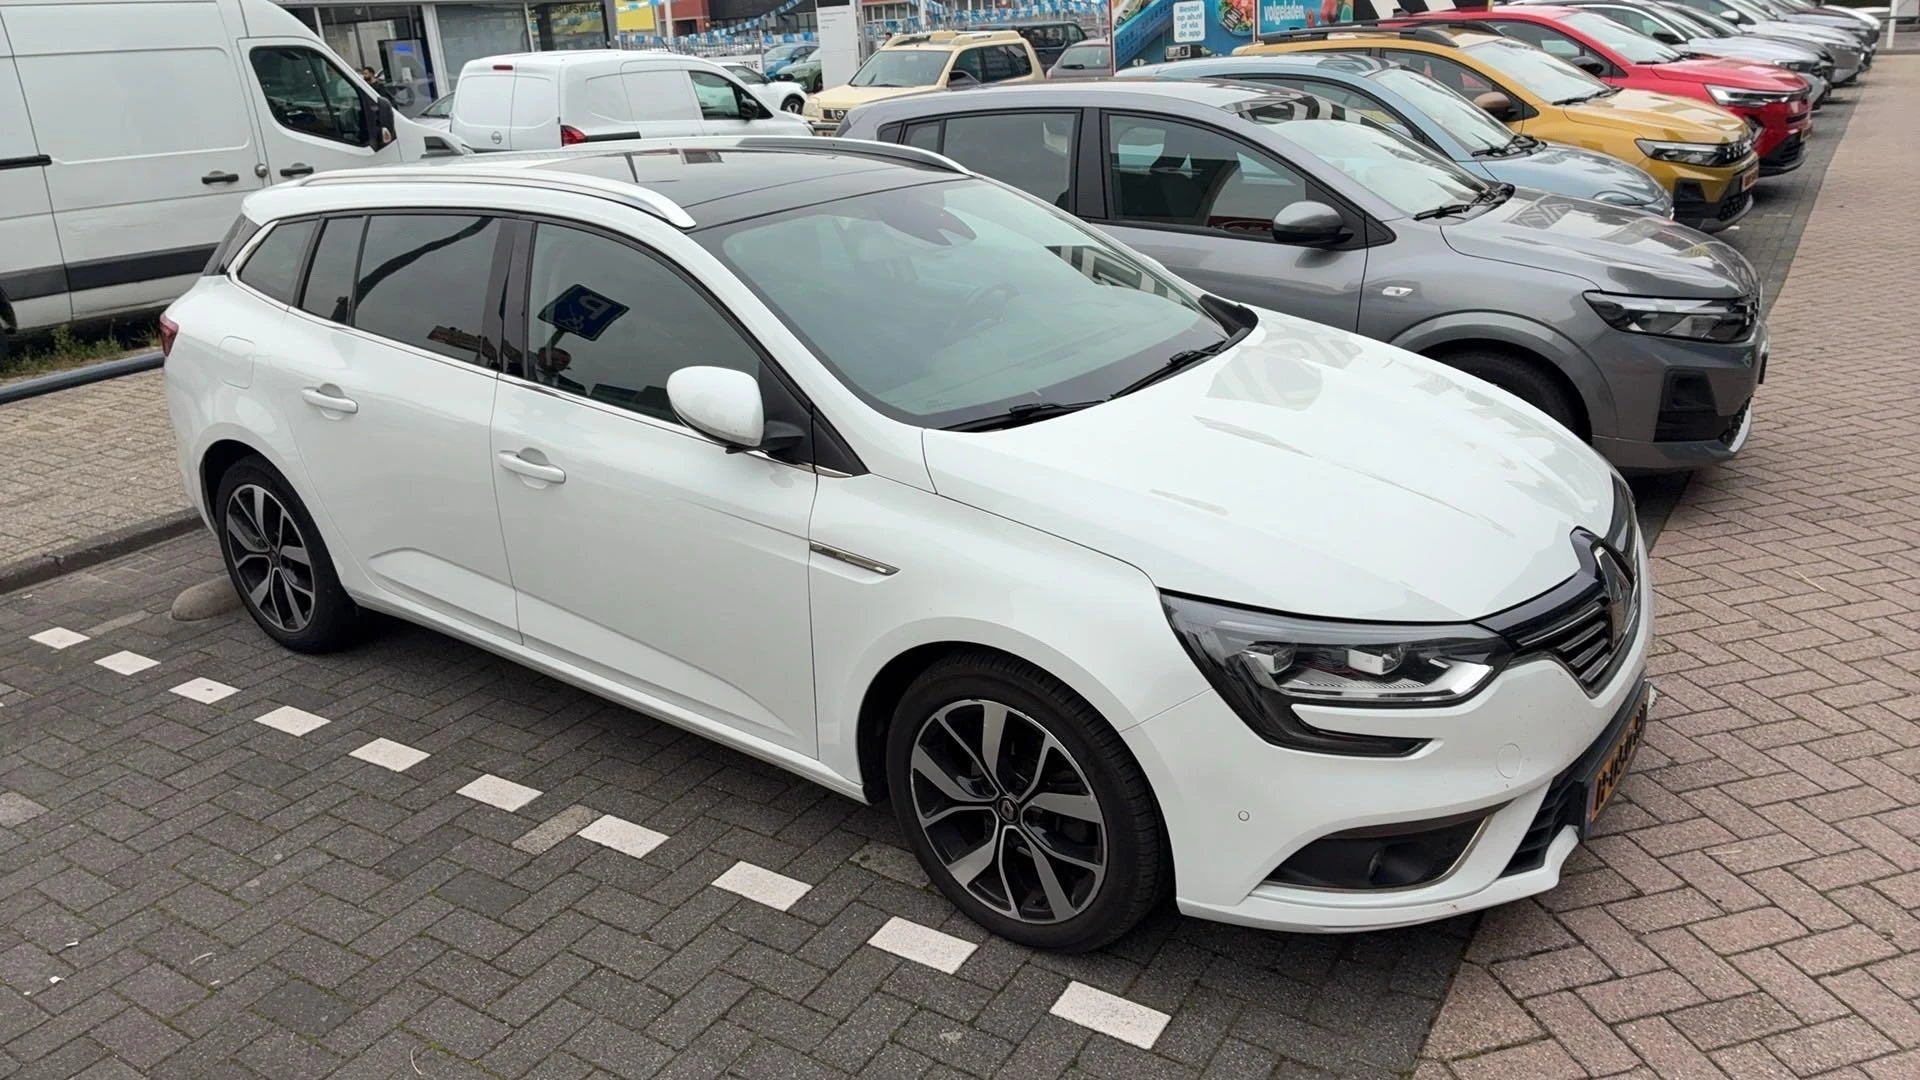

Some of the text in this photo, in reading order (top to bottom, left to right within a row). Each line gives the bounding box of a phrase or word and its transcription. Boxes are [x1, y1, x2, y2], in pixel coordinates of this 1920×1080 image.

[1179, 5, 1200, 13] Bestel
[1176, 12, 1202, 22] op ah.nl
[1188, 30, 1201, 38] app
